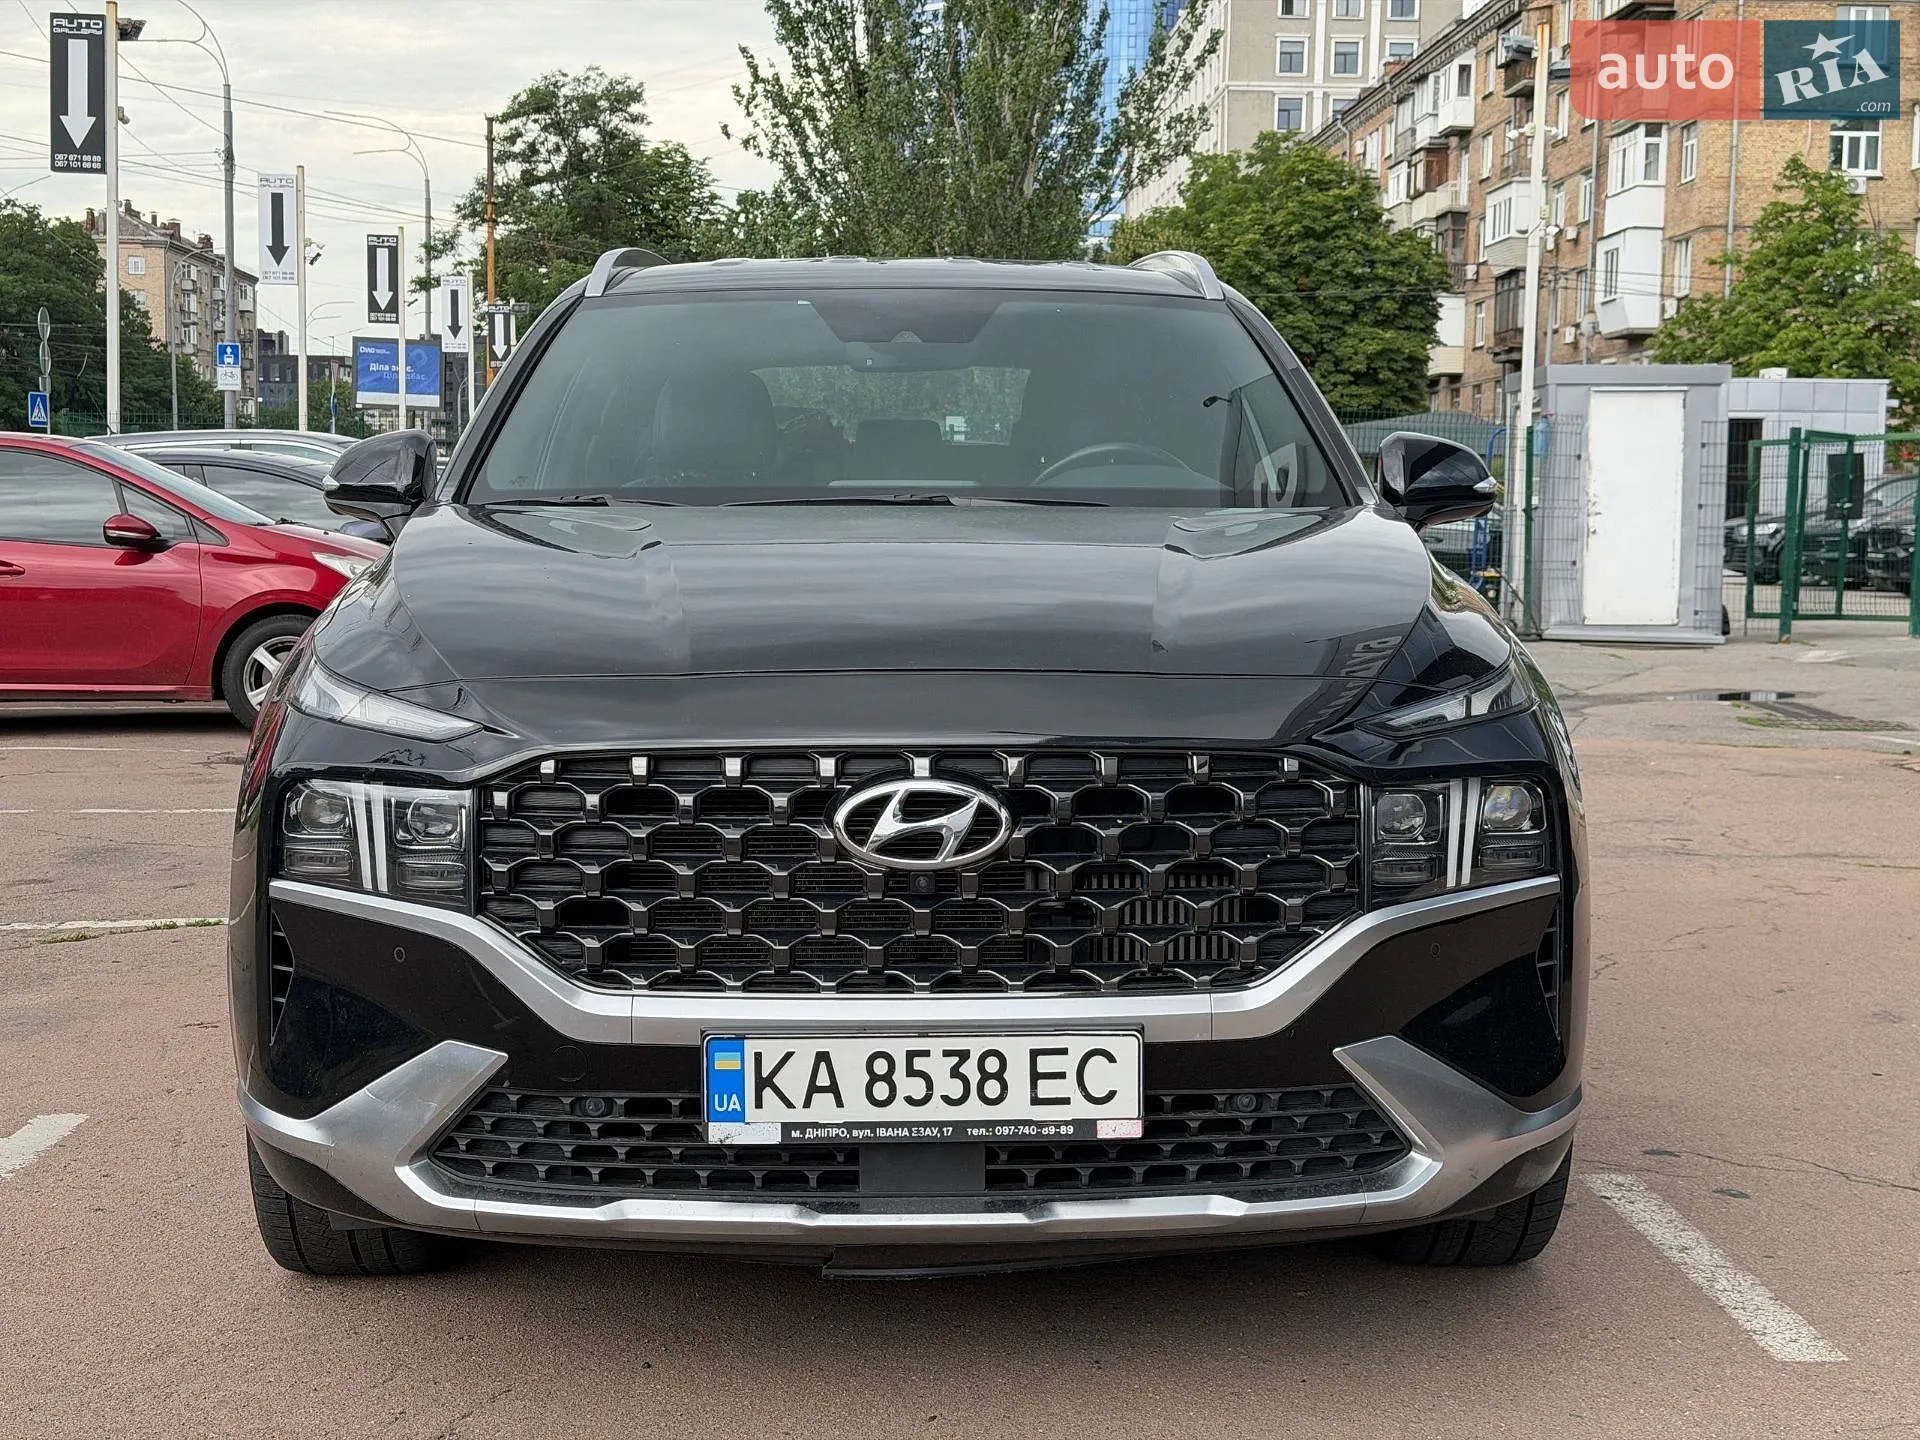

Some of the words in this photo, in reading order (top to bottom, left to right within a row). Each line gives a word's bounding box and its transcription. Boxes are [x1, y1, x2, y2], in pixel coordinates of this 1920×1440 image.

[53, 18, 103, 28] AUTO
[53, 27, 103, 35] GALLERY
[753, 1049, 845, 1110] KA
[864, 1047, 1009, 1108] 8538
[1029, 1047, 1118, 1107] EC
[714, 1093, 742, 1113] UA
[791, 1129, 803, 1138] м.
[805, 1127, 850, 1139] ДНІПРО,
[852, 1128, 874, 1139] вул.
[876, 1127, 910, 1137] ІВАНА
[942, 1127, 953, 1137] 17
[966, 1127, 993, 1136] тел.:
